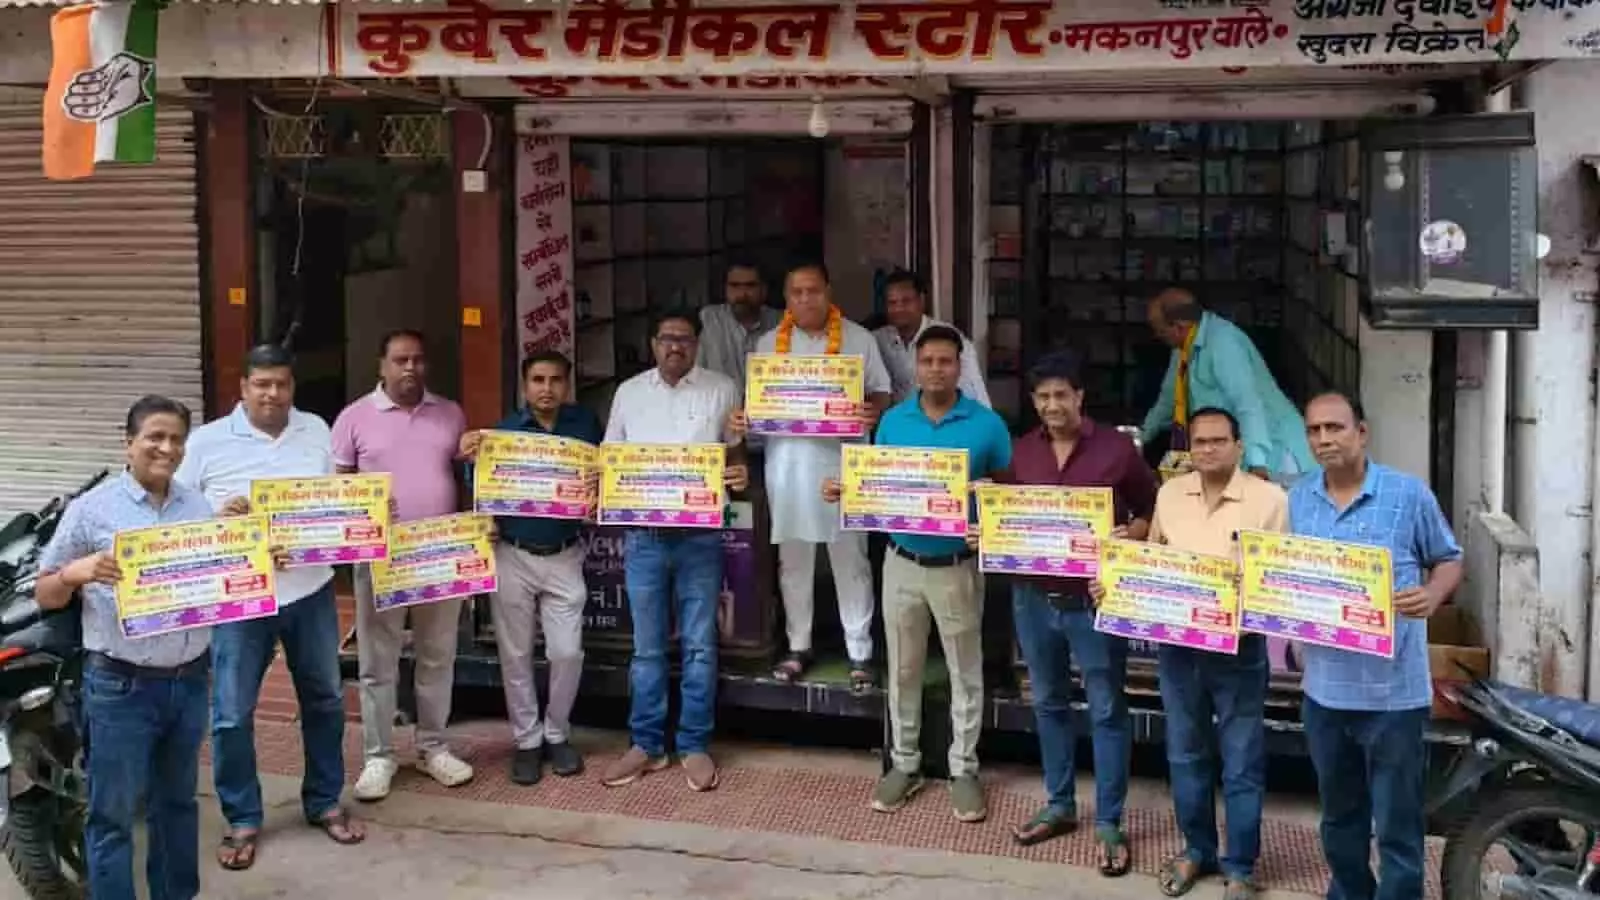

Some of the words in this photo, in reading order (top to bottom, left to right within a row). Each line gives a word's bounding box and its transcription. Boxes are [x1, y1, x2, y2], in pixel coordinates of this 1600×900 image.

[356, 0, 554, 75] कुबेर
[1063, 18, 1212, 59] मकनपुर
[1212, 7, 1273, 49] वाले
[1296, 32, 1377, 64] खुदरा
[1384, 22, 1485, 54] विक्रेत
